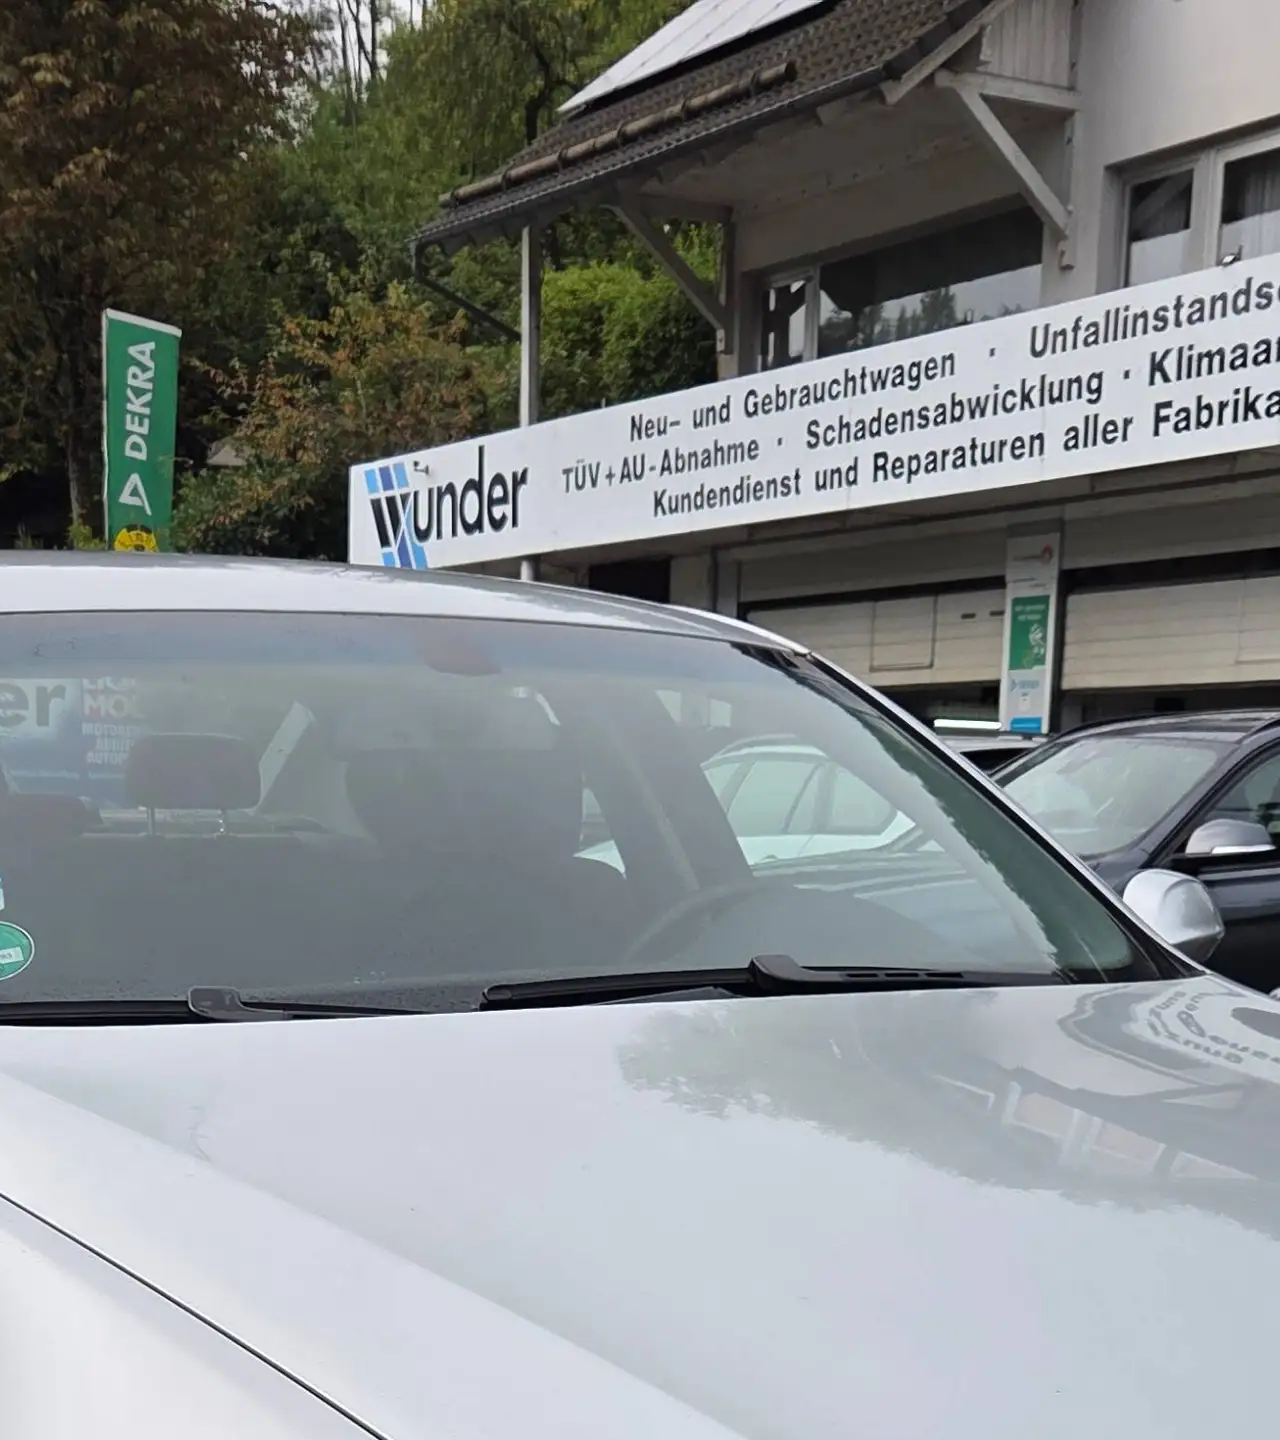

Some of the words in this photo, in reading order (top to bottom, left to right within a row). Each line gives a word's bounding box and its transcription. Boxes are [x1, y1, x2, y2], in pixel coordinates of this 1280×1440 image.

[124, 341, 156, 461] DEKRA
[630, 414, 680, 442] Neu-
[693, 395, 731, 430] und
[744, 352, 955, 418] Gebrauchtwagen
[806, 371, 1104, 449] Schadensabwicklung
[367, 445, 528, 566] Wunder
[653, 468, 801, 517] Kundendienst
[815, 456, 859, 492] und
[873, 431, 1045, 484] Reparaturen
[1063, 412, 1134, 451] aller
